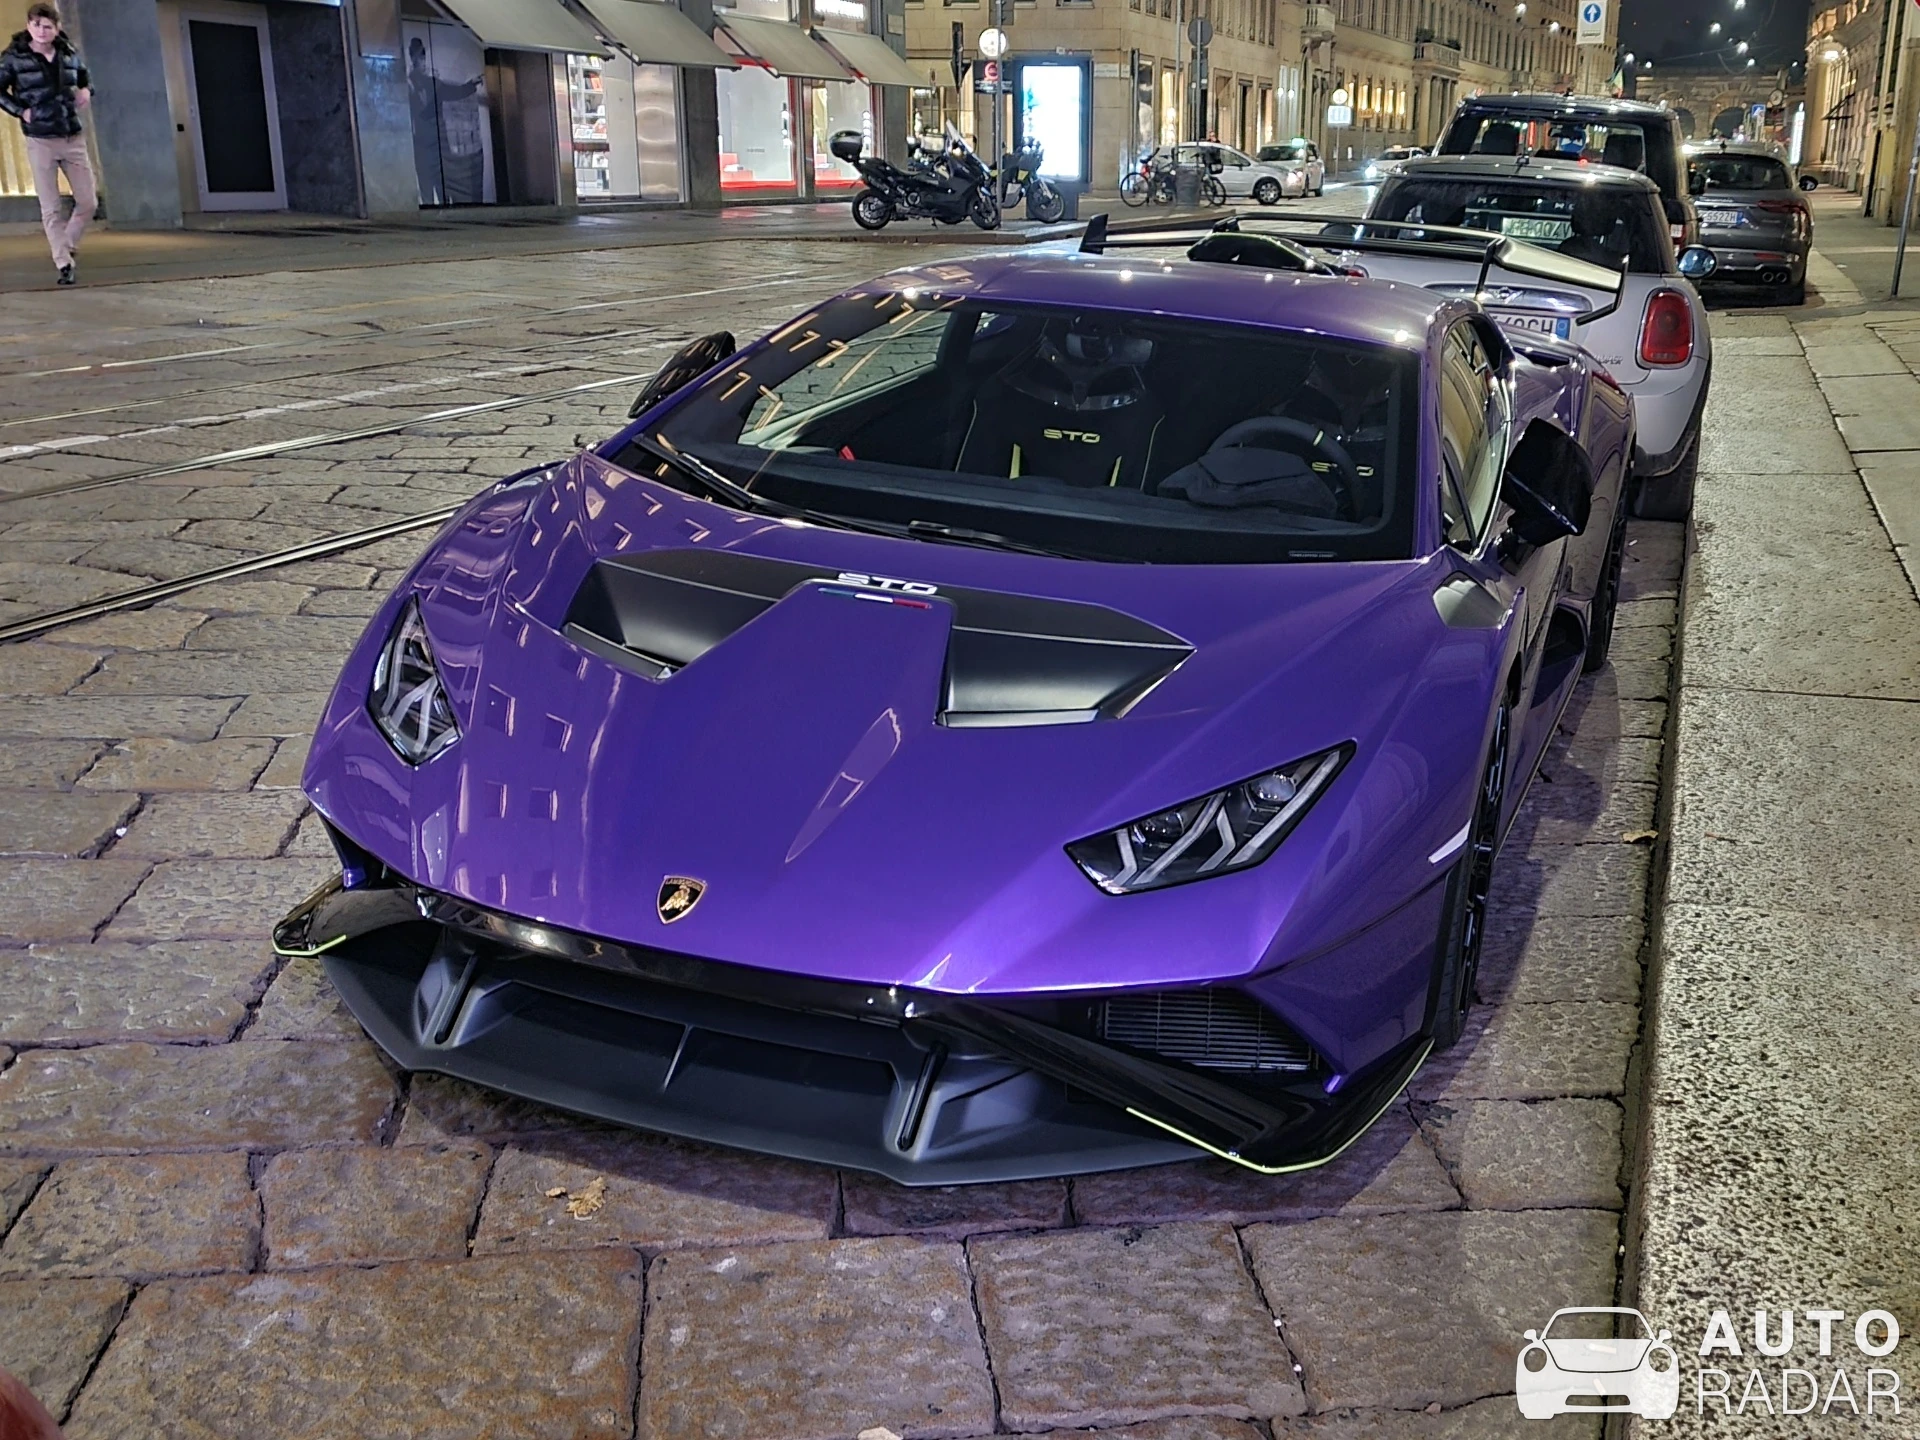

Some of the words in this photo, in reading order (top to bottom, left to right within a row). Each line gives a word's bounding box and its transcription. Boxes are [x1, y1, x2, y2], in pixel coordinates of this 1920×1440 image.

[1043, 428, 1100, 443] STO
[1311, 461, 1375, 477] SO
[838, 572, 938, 595] STO
